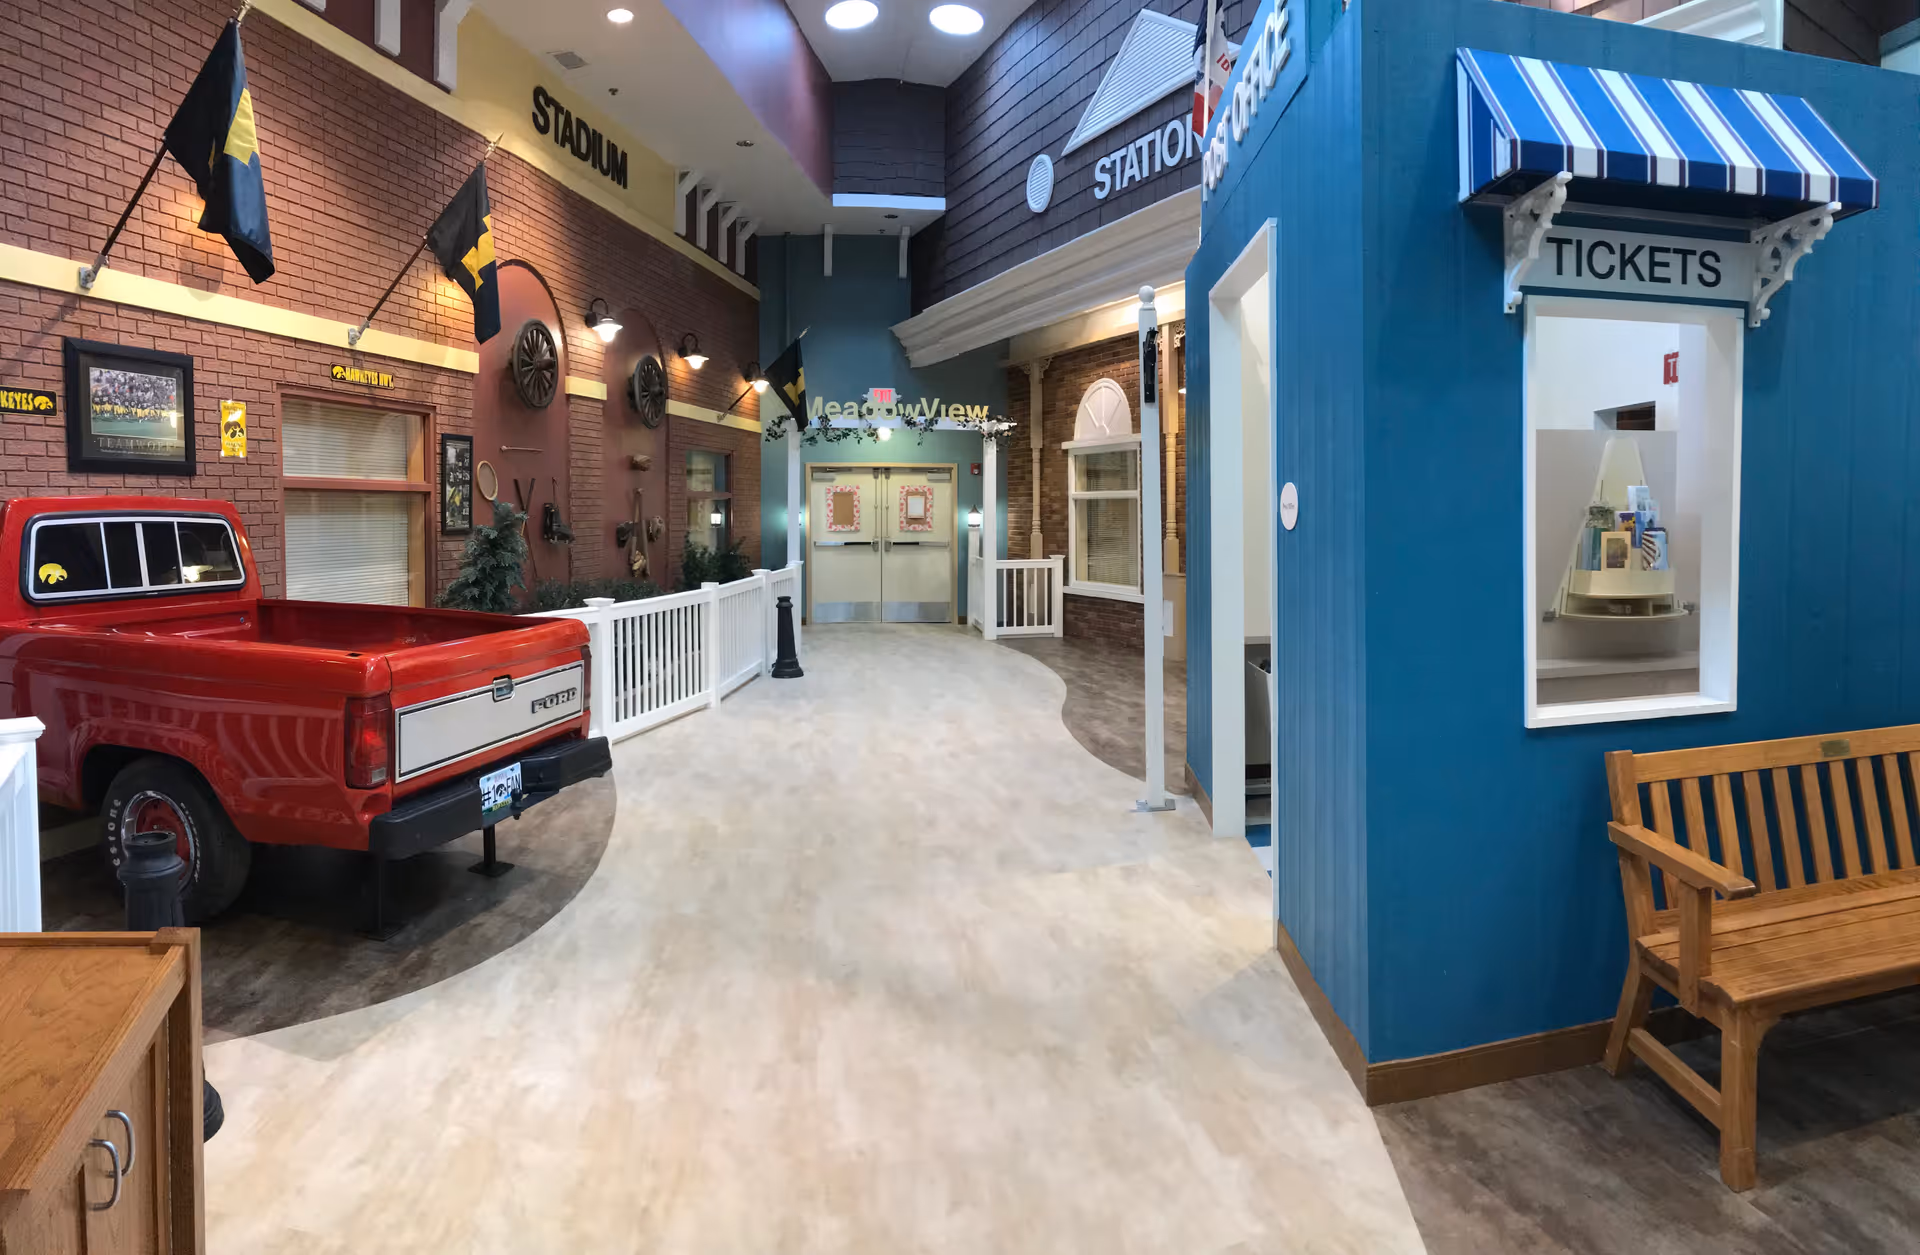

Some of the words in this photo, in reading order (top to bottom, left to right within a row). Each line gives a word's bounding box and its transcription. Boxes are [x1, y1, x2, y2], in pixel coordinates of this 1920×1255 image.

[1202, 105, 1232, 202] POST
[1232, 0, 1290, 142] OFFICE
[532, 84, 628, 190] STADIUM
[1546, 236, 1722, 288] TICKETS
[531, 687, 578, 714] FORD
[481, 783, 498, 808] #1
